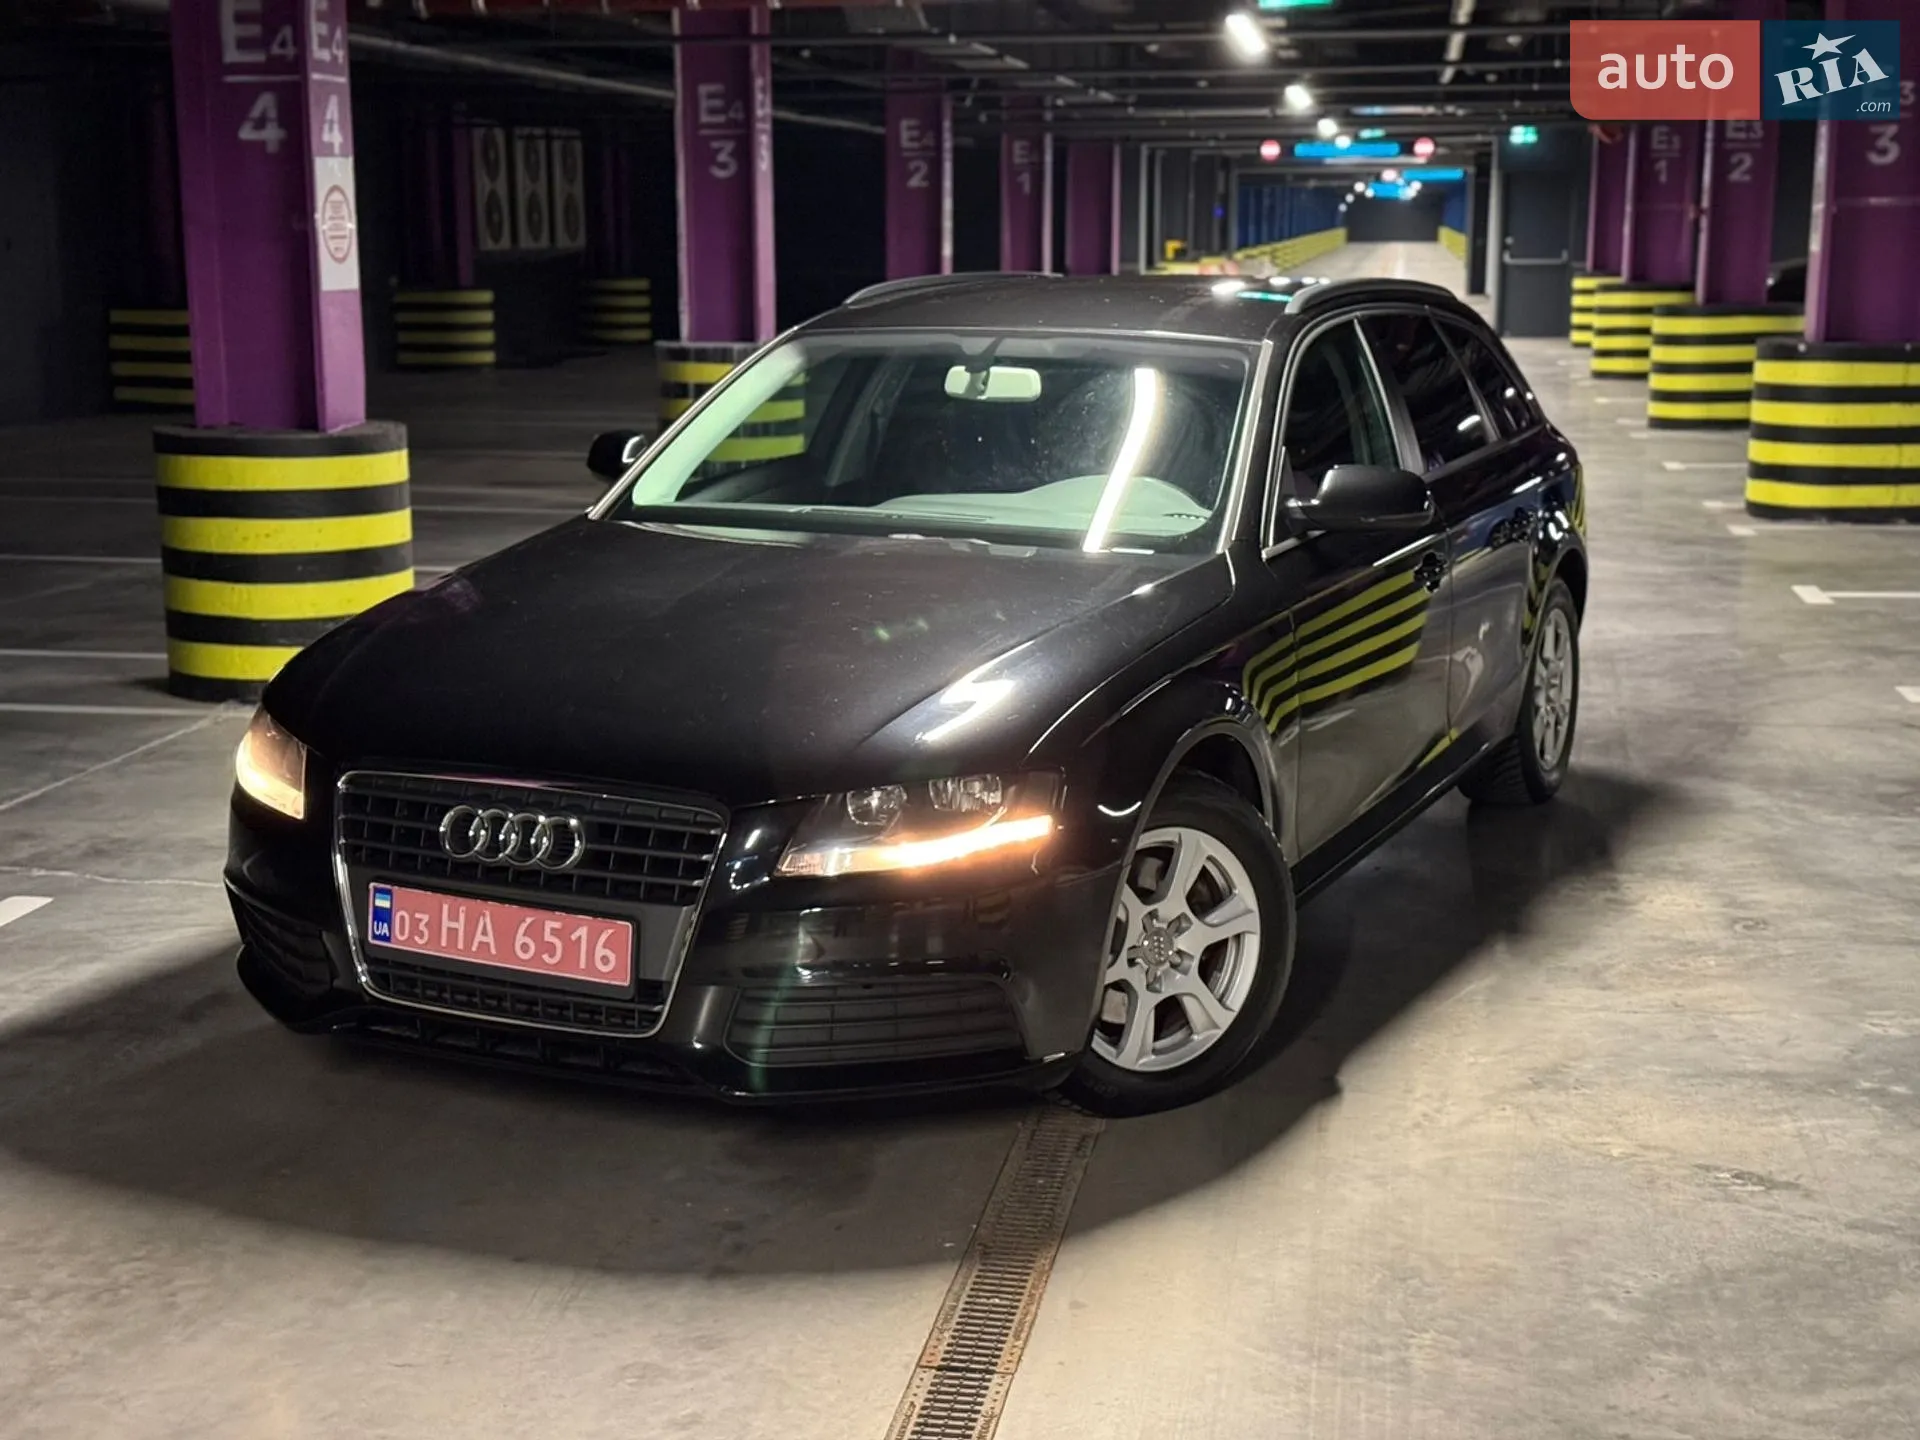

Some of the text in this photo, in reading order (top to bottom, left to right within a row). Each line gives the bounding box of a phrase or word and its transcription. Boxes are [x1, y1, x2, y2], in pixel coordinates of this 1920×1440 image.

[237, 91, 287, 153] 4
[322, 94, 343, 154] 4
[708, 140, 739, 179] 3
[1866, 124, 1900, 165] 3
[907, 160, 930, 187] 2
[1016, 171, 1030, 194] 1
[1654, 159, 1668, 184] 1
[1727, 151, 1754, 182] 2
[373, 920, 389, 937] UA
[394, 903, 617, 973] 03 HA 6516
